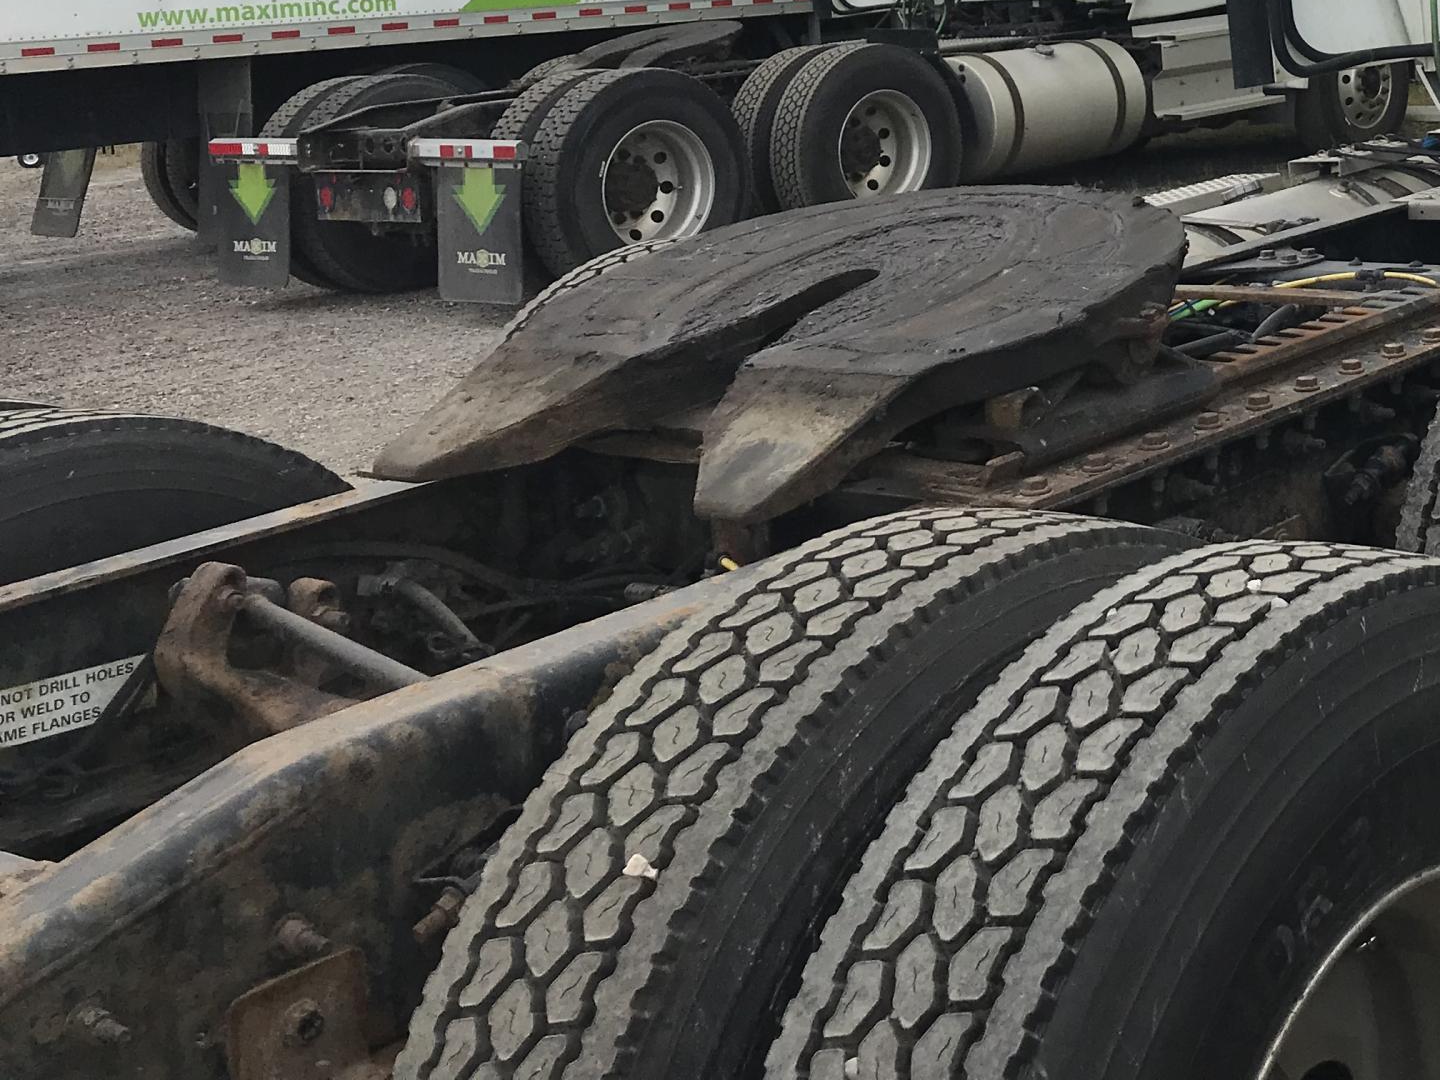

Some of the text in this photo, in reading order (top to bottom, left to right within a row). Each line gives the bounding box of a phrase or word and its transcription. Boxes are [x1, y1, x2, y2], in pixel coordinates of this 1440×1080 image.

[0, 662, 134, 706] NOT DRILL HOLES
[21, 699, 65, 719] WELD
[71, 691, 90, 706] TO
[32, 706, 101, 735] FLANGES
